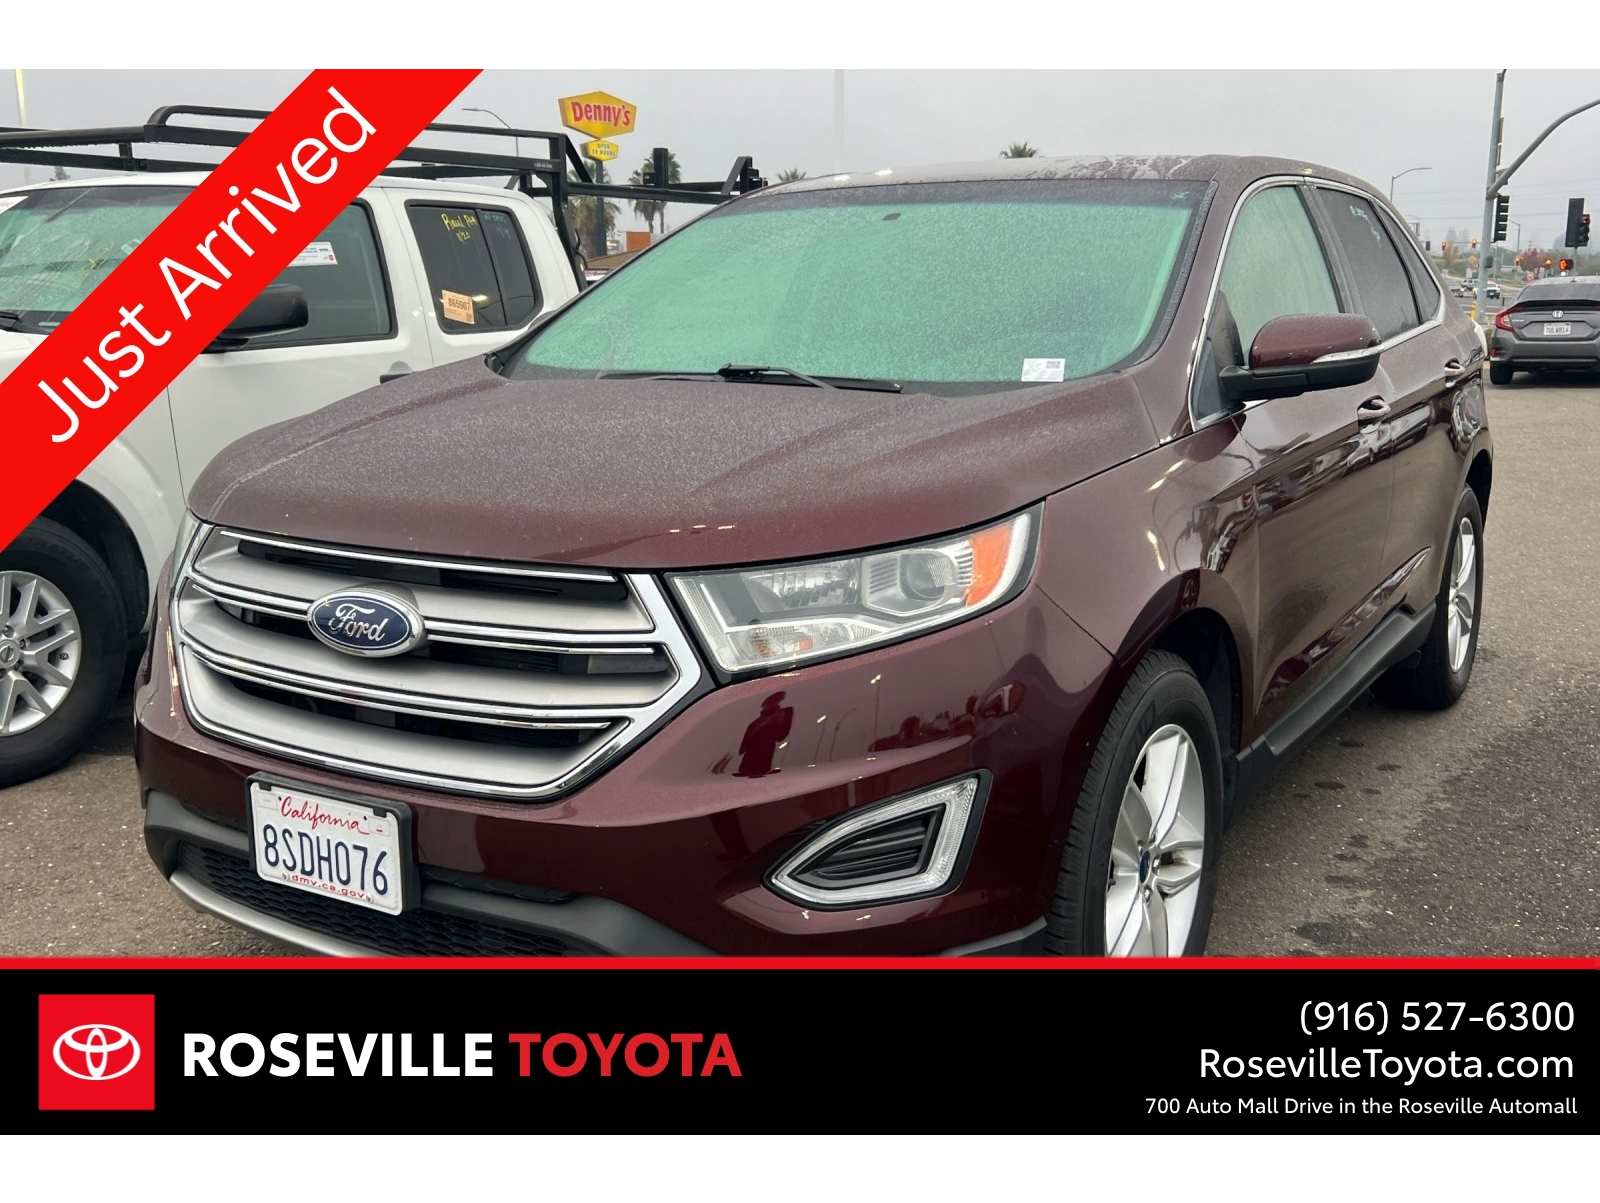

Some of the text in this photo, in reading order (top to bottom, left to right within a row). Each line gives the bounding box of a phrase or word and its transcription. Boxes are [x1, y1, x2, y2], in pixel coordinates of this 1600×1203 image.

[571, 102, 631, 127] Denny's
[328, 603, 389, 642] Ford
[281, 796, 369, 834] California
[263, 824, 388, 895] 8SDH076
[291, 874, 367, 900] dmv.ca.gov
